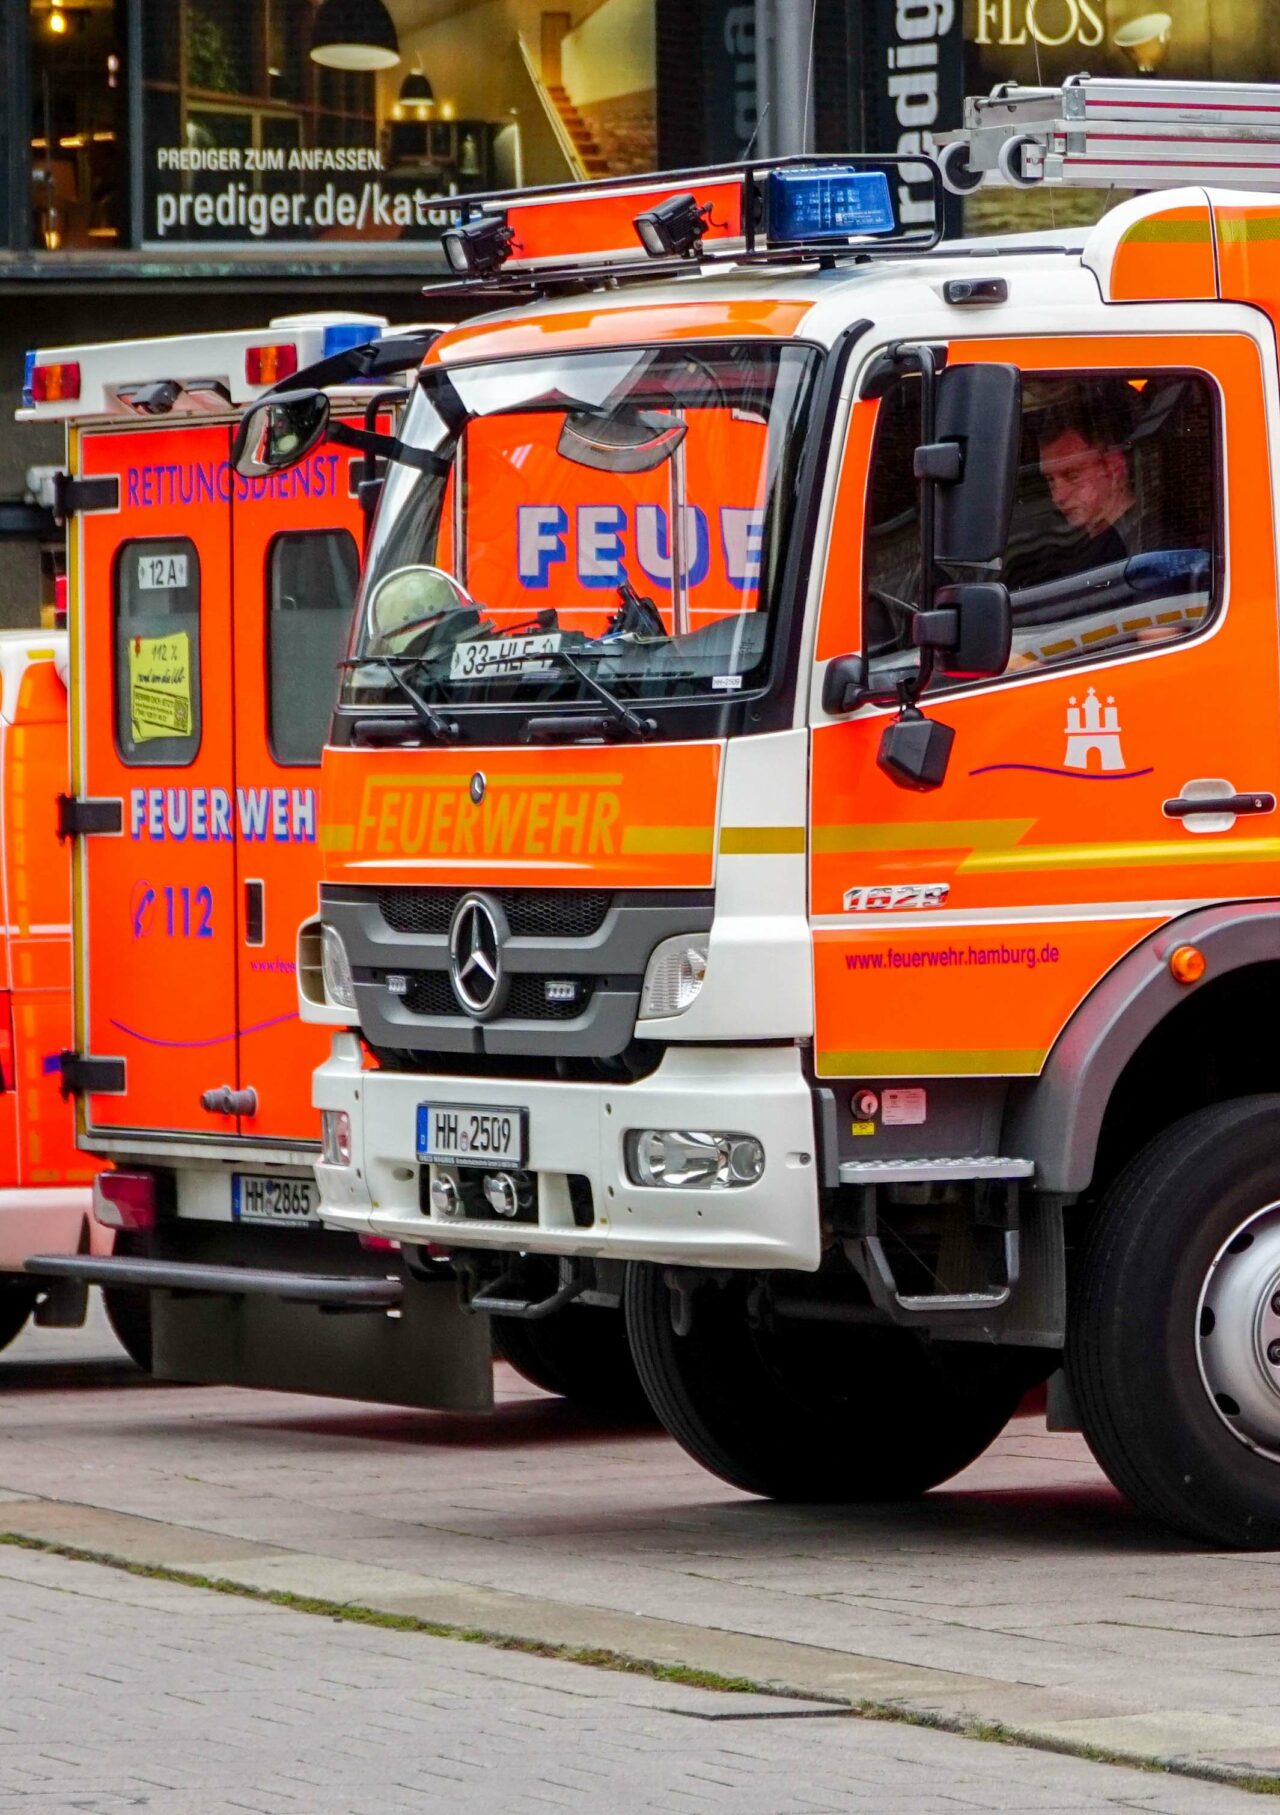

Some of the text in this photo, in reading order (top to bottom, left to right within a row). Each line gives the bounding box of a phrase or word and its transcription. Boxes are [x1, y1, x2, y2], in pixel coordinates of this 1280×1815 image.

[974, 0, 1104, 46] FLOS
[157, 148, 384, 171] PREDIGER ZUM ANFASSEN.
[150, 558, 177, 586] 12 A
[347, 774, 623, 855] FEUERWEHR
[164, 886, 213, 937] 112
[845, 944, 1060, 970] www.feuerwehr.hamburg.de
[435, 1113, 458, 1150] HH
[469, 1115, 511, 1153] 2509
[245, 1181, 310, 1215] HH 2865
